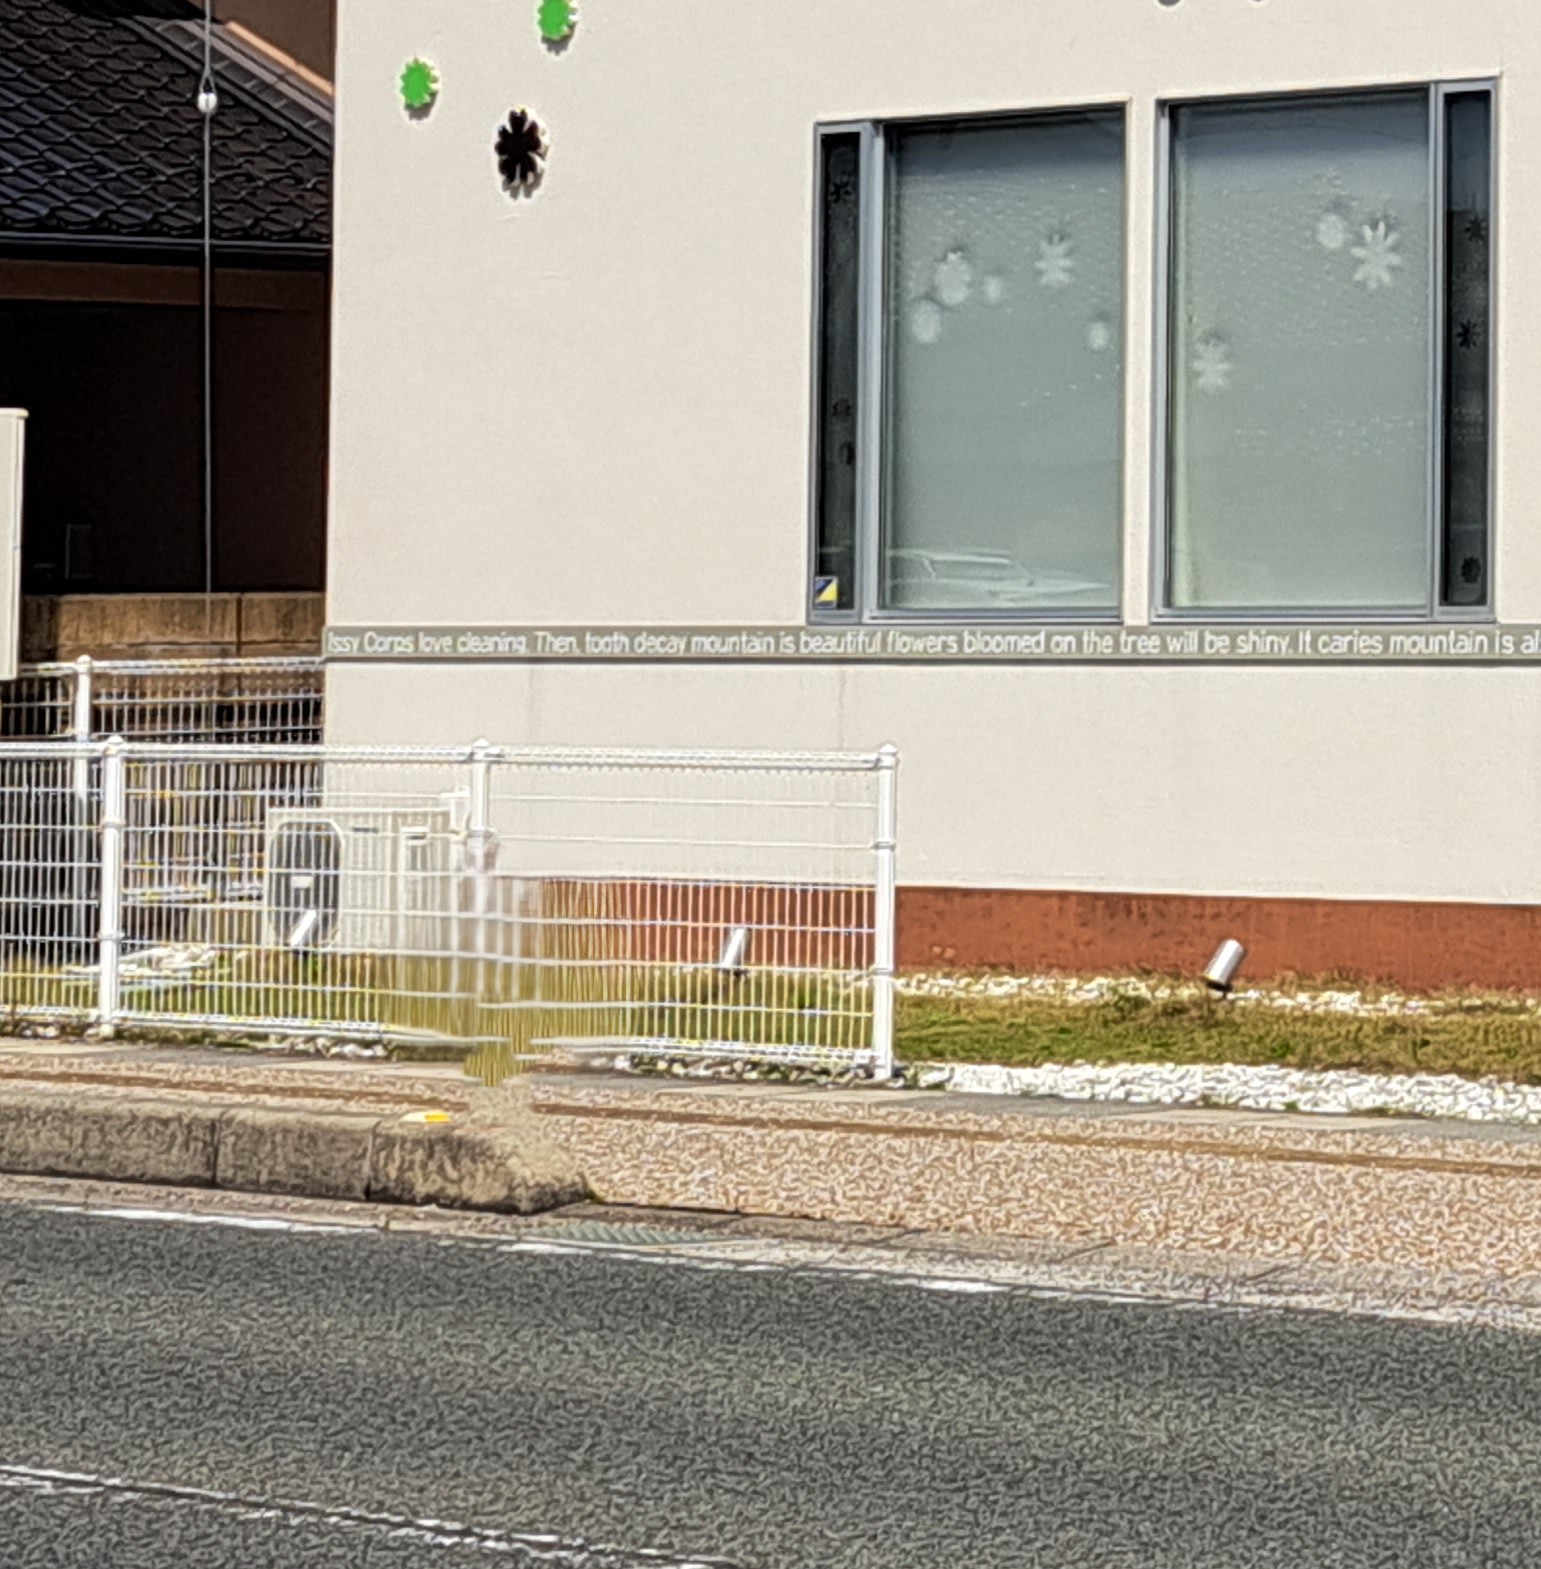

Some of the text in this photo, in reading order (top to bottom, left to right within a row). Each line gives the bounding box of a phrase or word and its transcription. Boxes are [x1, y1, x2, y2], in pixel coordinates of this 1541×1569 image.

[418, 632, 453, 654] love
[585, 632, 630, 653] tooth
[633, 632, 687, 655] decay
[690, 631, 775, 654] mountain
[779, 632, 796, 653] is
[799, 631, 882, 654] beautiful
[886, 630, 958, 654] flowers
[962, 630, 1046, 654] bloomed
[1050, 634, 1076, 654] on
[1081, 630, 1113, 654] the
[1119, 630, 1161, 654] tree
[1166, 630, 1199, 654] will
[1203, 630, 1230, 654] be
[1298, 631, 1312, 654] It
[1317, 630, 1384, 654] caries
[1389, 629, 1489, 654] mountain
[1494, 629, 1514, 654] is
